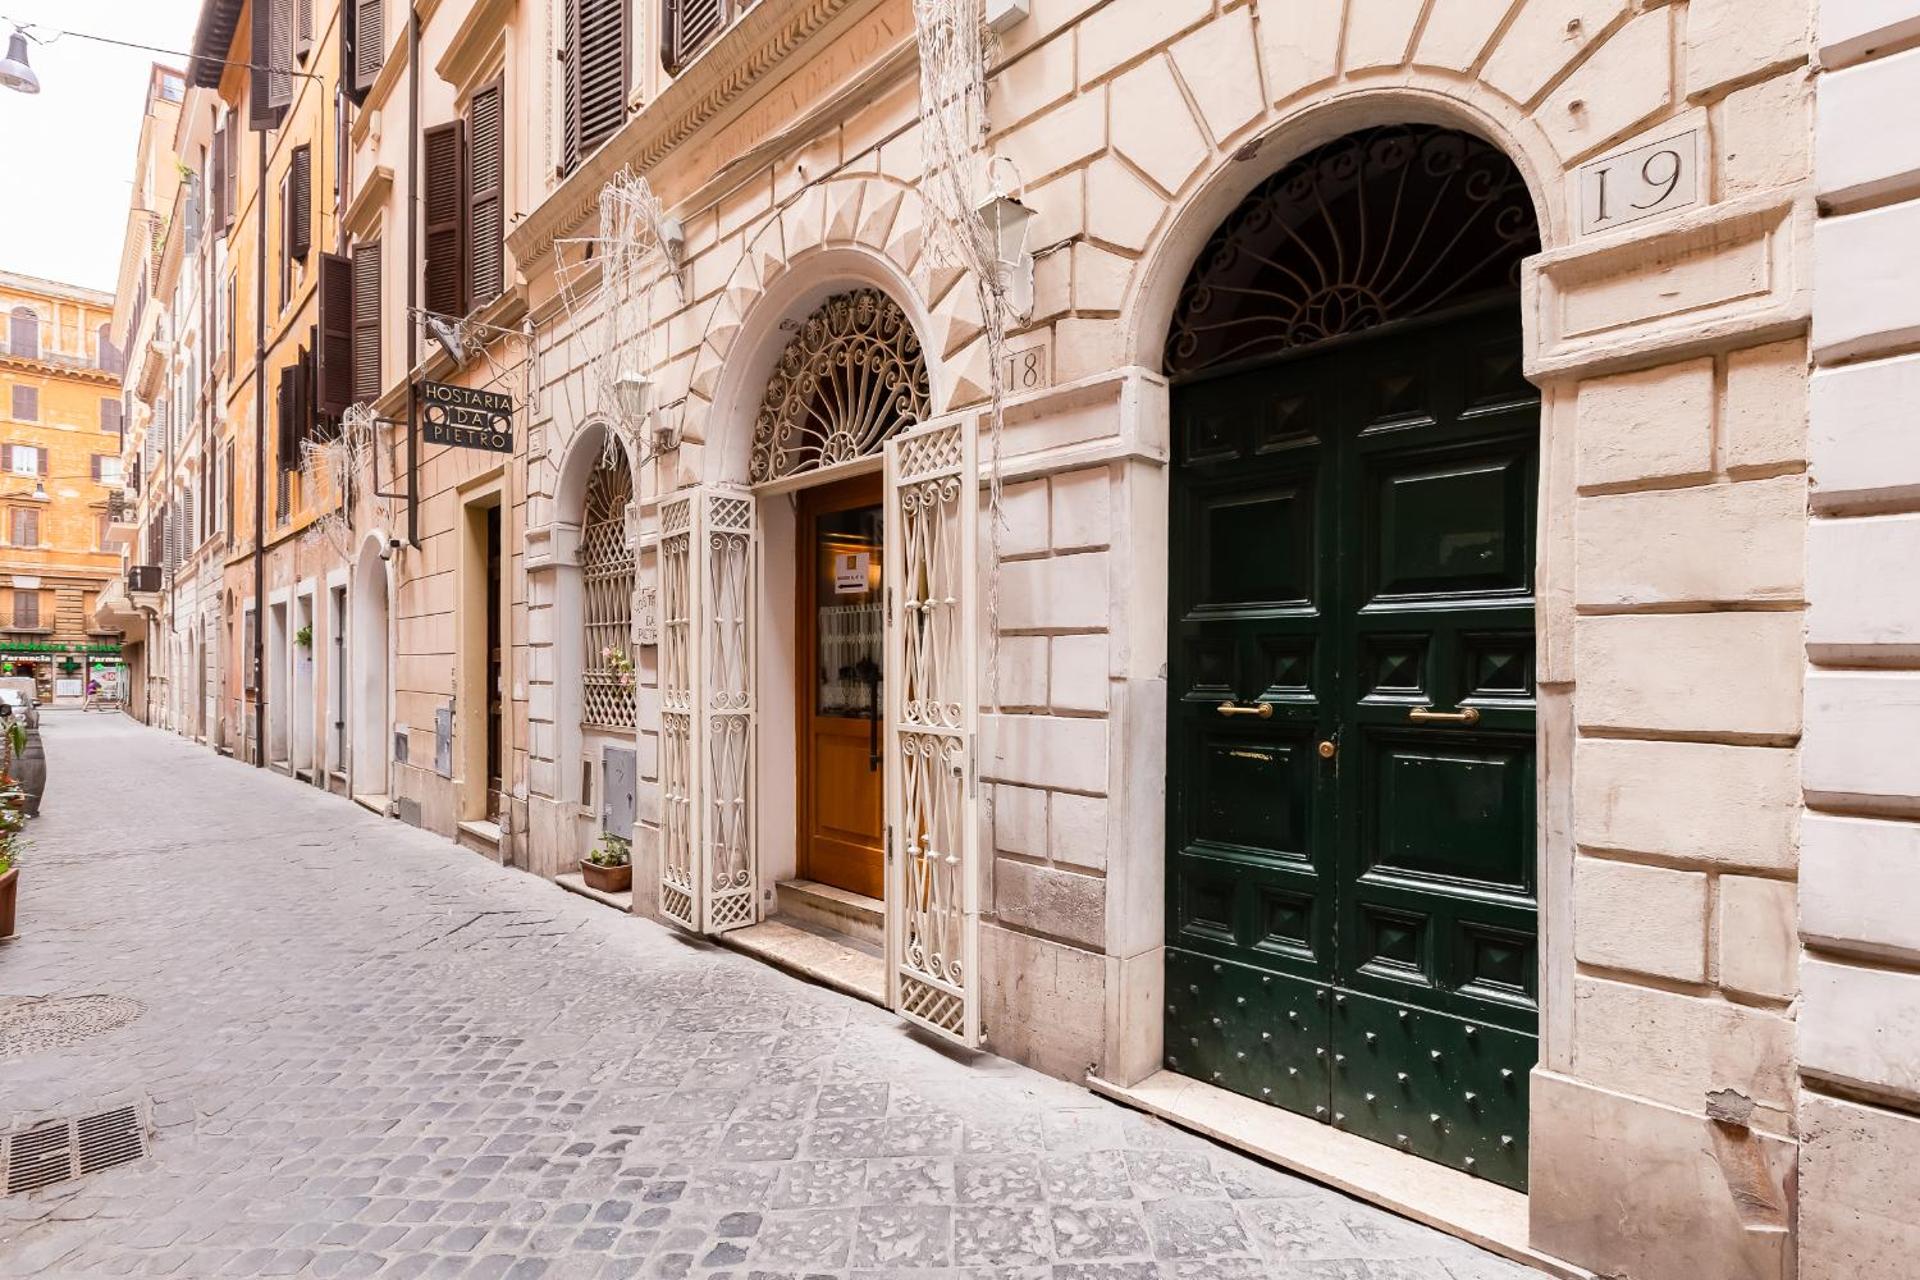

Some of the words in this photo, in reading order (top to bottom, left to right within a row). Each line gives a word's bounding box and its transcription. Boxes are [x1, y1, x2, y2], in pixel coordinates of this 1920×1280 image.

[1593, 150, 1682, 224] 19
[1007, 351, 1038, 393] 18
[425, 384, 512, 411] HOSTARIA
[457, 410, 484, 426] DA
[433, 425, 505, 449] PIETRO
[0, 654, 51, 662] Farmacia
